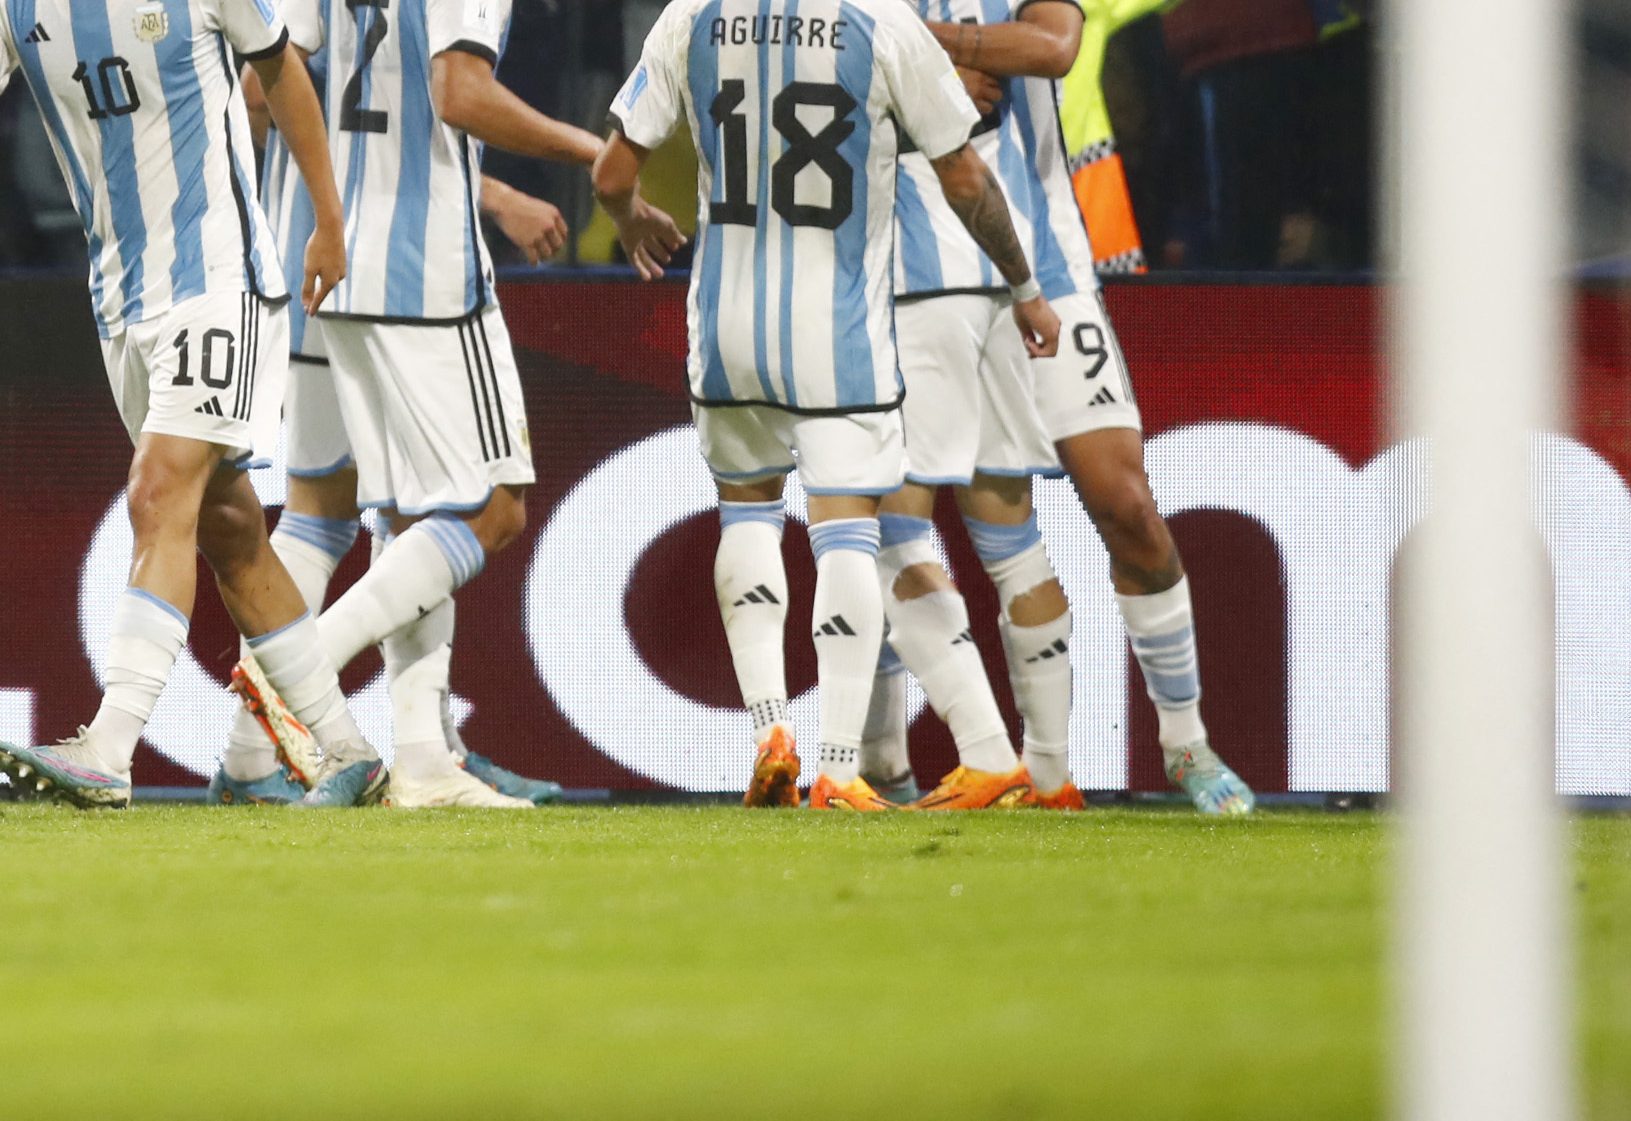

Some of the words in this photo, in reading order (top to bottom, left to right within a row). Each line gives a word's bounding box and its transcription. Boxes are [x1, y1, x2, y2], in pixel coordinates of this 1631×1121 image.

[709, 15, 848, 50] AGUIRRE
[71, 55, 141, 120] 10
[709, 78, 858, 230] 18
[171, 327, 235, 390] 10
[1072, 323, 1108, 379] 9
